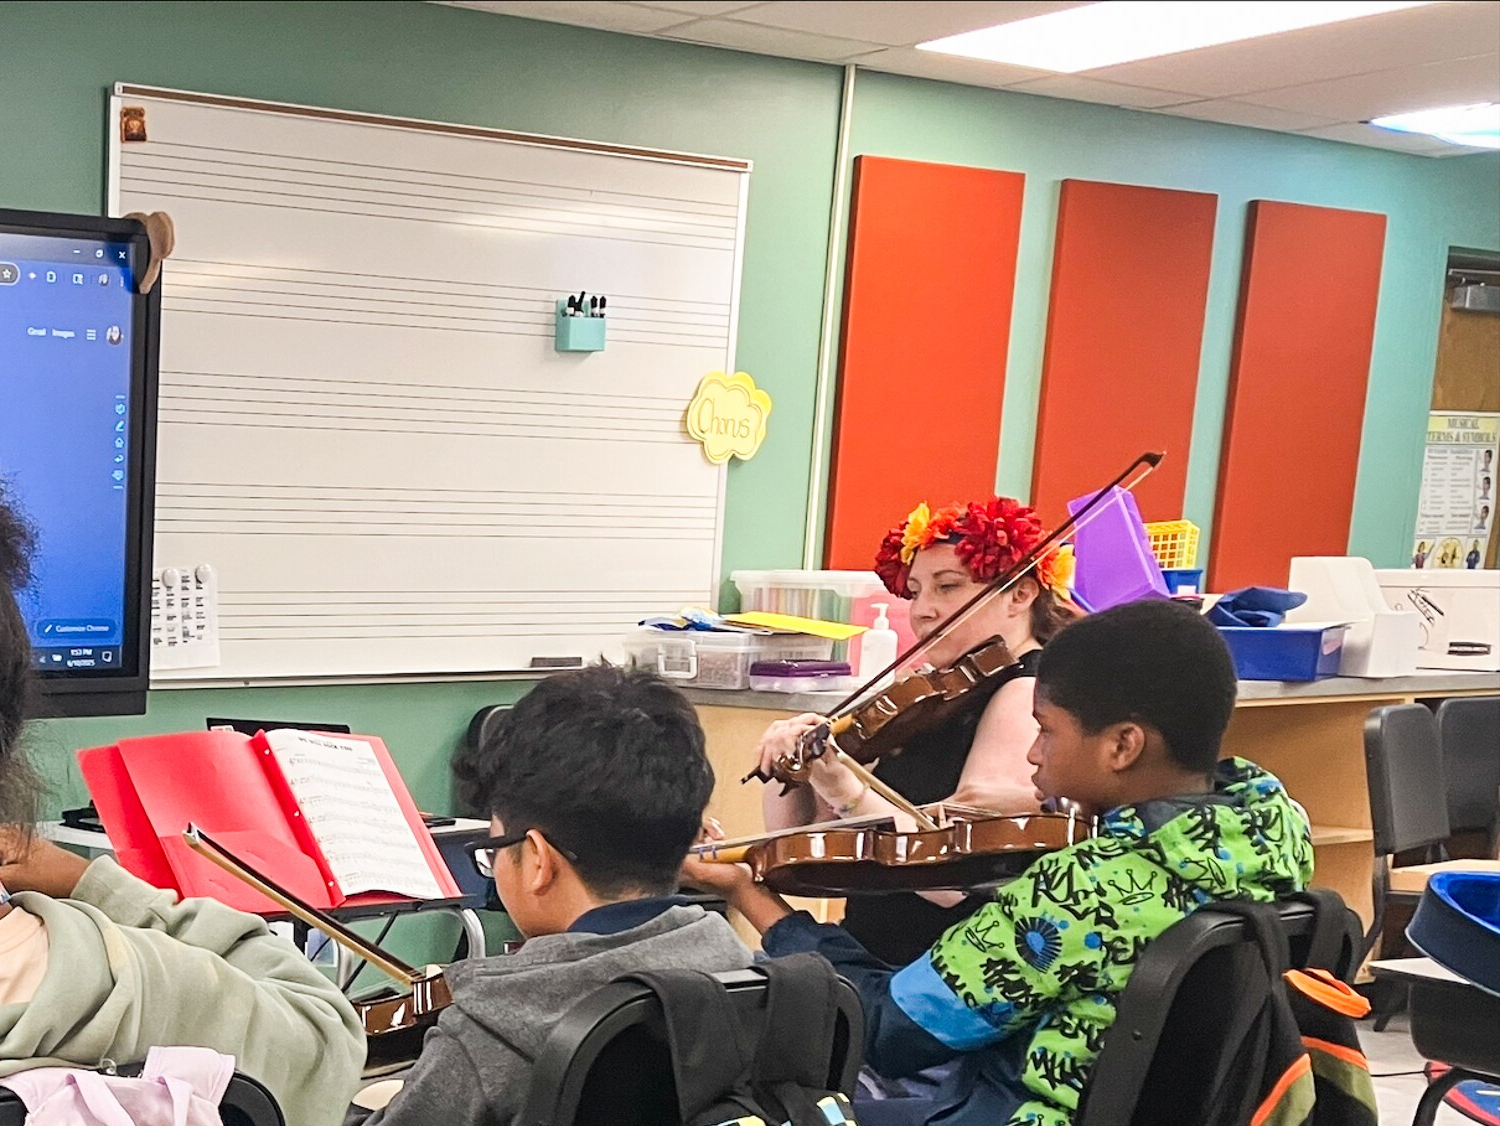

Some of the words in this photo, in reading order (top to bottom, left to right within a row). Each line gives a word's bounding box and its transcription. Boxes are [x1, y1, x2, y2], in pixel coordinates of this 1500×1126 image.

[698, 398, 750, 438] Chorus
[1448, 418, 1479, 430] MUSICAL
[1462, 432, 1496, 444] SYMBOLS
